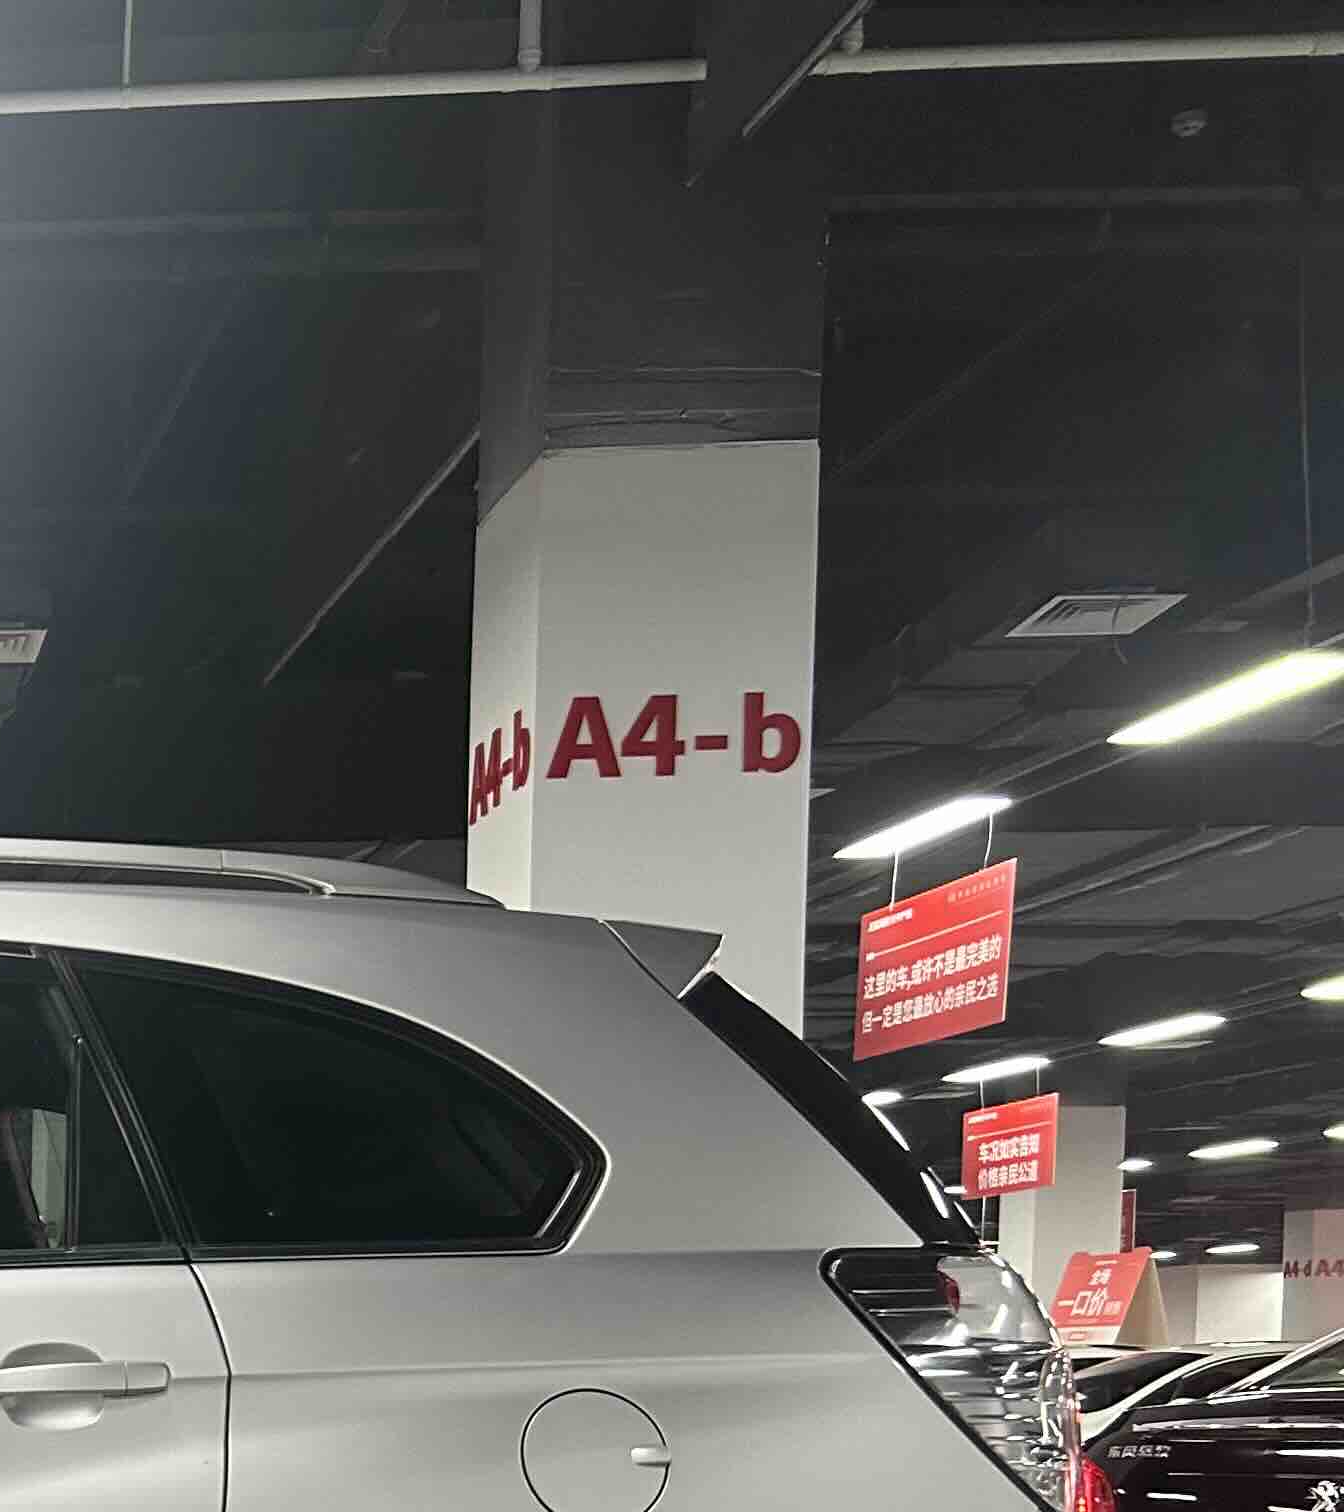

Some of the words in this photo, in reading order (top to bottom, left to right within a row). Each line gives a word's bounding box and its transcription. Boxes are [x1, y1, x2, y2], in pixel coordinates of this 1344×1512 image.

[546, 691, 801, 778] A4-b
[469, 709, 531, 826] A4-b
[977, 1160, 1040, 1191] 价格亲民公道
[978, 1132, 1040, 1164] 车况如实告知
